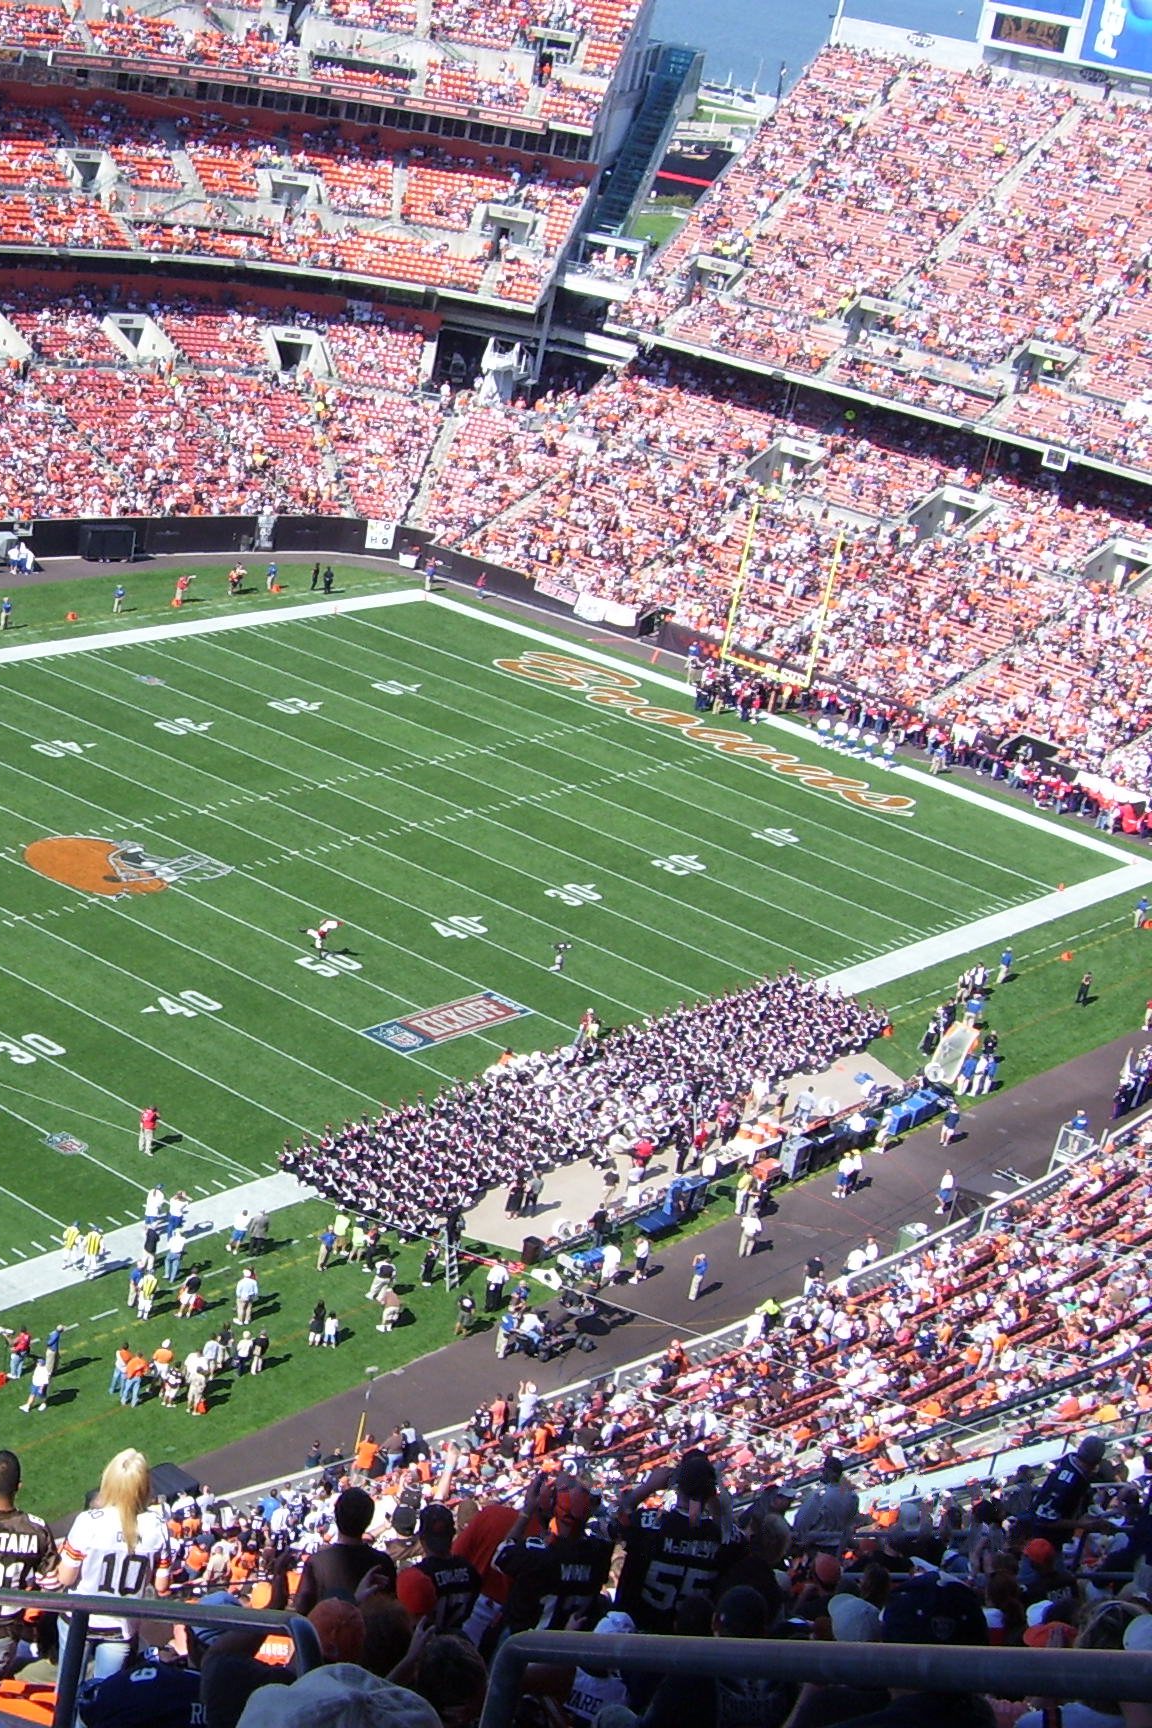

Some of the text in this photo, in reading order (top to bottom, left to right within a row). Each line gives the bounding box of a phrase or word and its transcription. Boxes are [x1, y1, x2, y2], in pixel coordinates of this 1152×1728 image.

[750, 827, 801, 847] 10
[650, 854, 708, 876] 20
[543, 883, 603, 907] 30
[430, 915, 489, 940] 40
[293, 952, 364, 979] 50
[156, 989, 224, 1018] 40
[408, 999, 507, 1037] KICKOFF
[98, 1553, 150, 1597] 10
